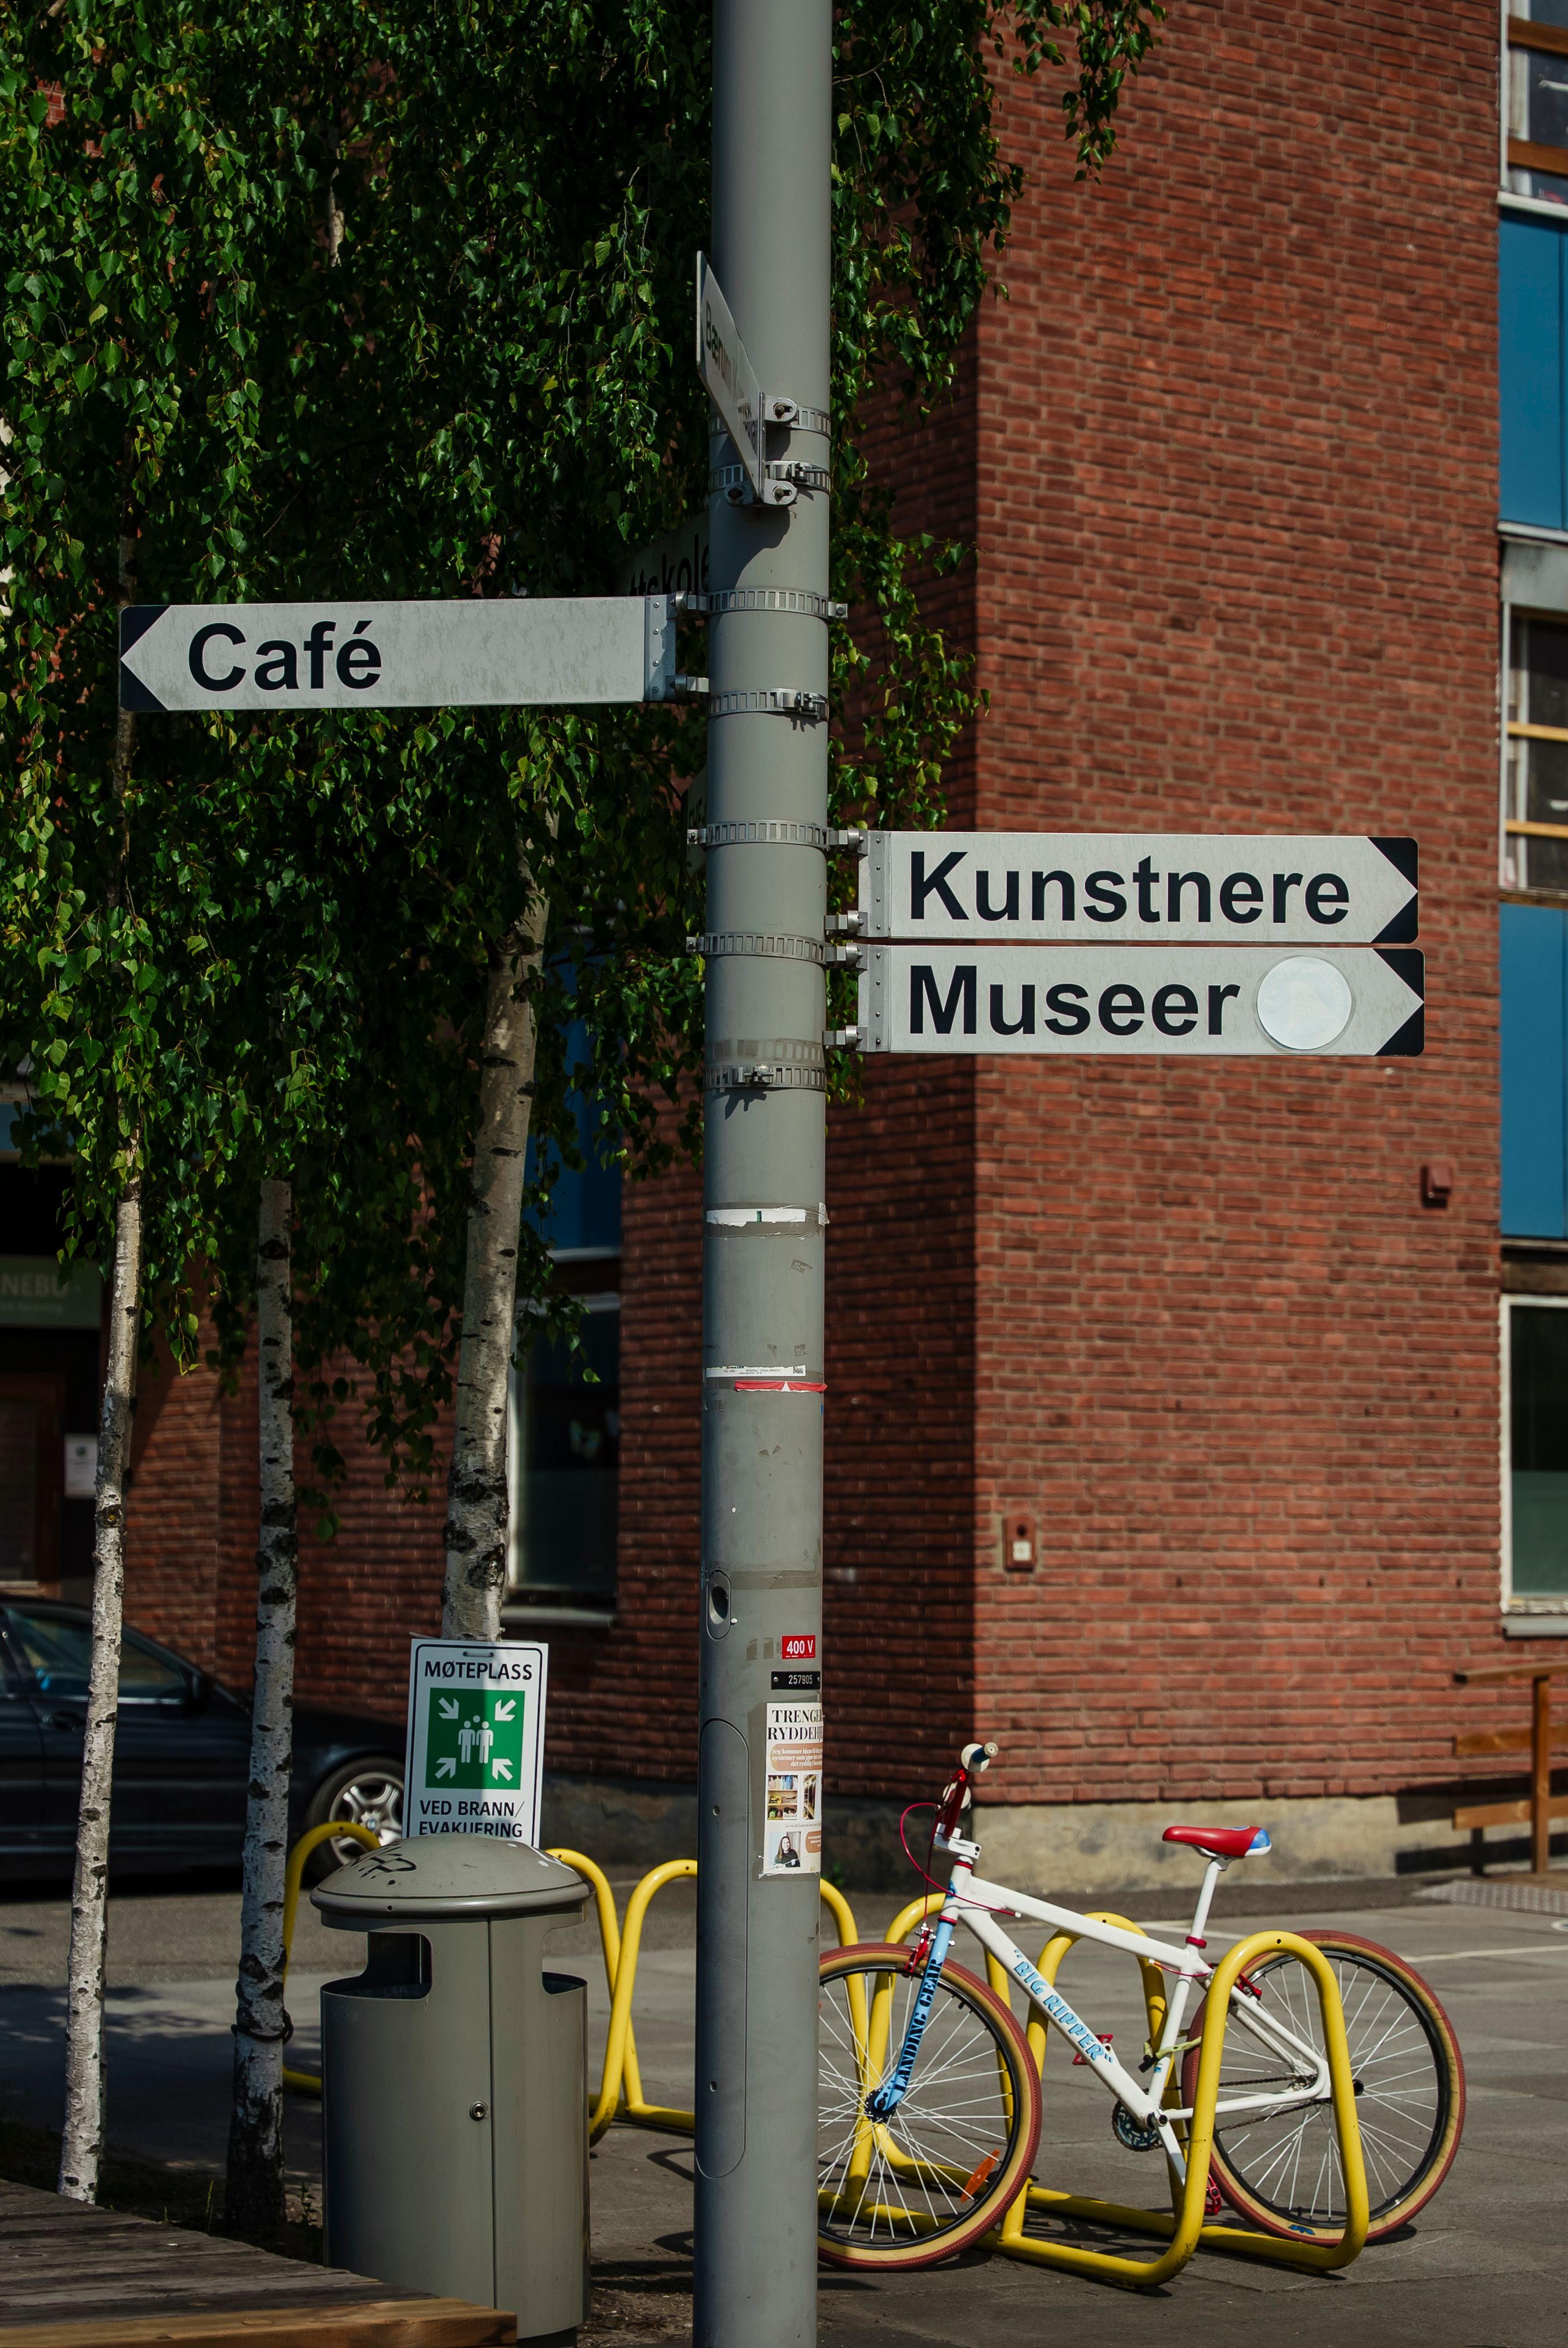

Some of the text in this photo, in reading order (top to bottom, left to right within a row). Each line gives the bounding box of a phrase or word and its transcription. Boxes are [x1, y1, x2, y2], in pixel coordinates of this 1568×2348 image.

[706, 299, 732, 395] Bærum
[188, 619, 382, 692] Café
[911, 850, 1350, 925] Kunstnere
[909, 964, 1241, 1036] Museer
[786, 1639, 814, 1654] 400 V
[424, 1660, 533, 1680] MØTEPLASS
[788, 1675, 813, 1685] 257905
[418, 1821, 523, 1838] EVAKUERING
[420, 1799, 525, 1818] VED BRANN/
[893, 1958, 943, 2093] LANDING GEAR
